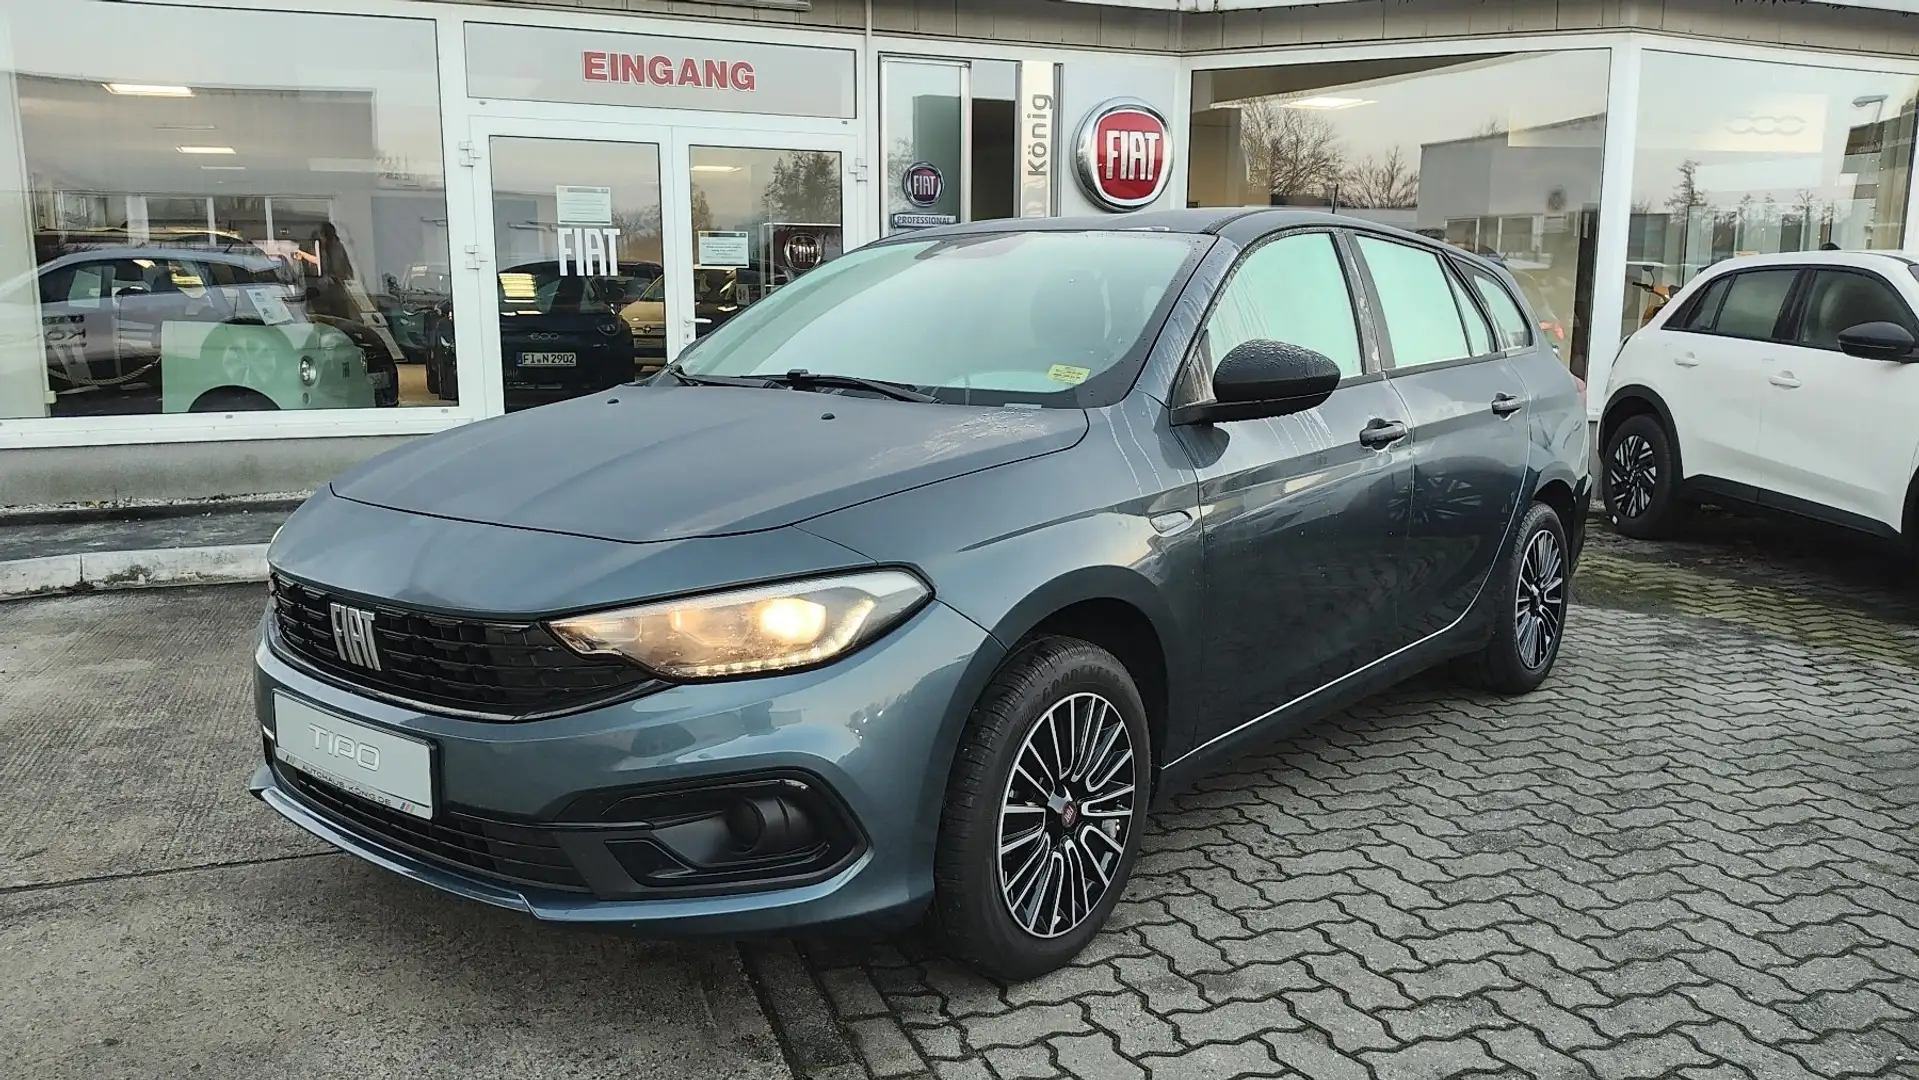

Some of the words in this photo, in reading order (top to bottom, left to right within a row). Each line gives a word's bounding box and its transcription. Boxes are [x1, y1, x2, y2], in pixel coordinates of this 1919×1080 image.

[583, 51, 756, 91] EINGANG
[1028, 94, 1053, 176] König
[1105, 130, 1160, 180] FIAT
[913, 175, 936, 195] FIAT
[896, 216, 950, 225] PROFESSIONAL
[558, 228, 621, 276] FIAT
[551, 354, 575, 364] 2902
[330, 602, 382, 672] FIAT
[308, 722, 380, 772] TIPO
